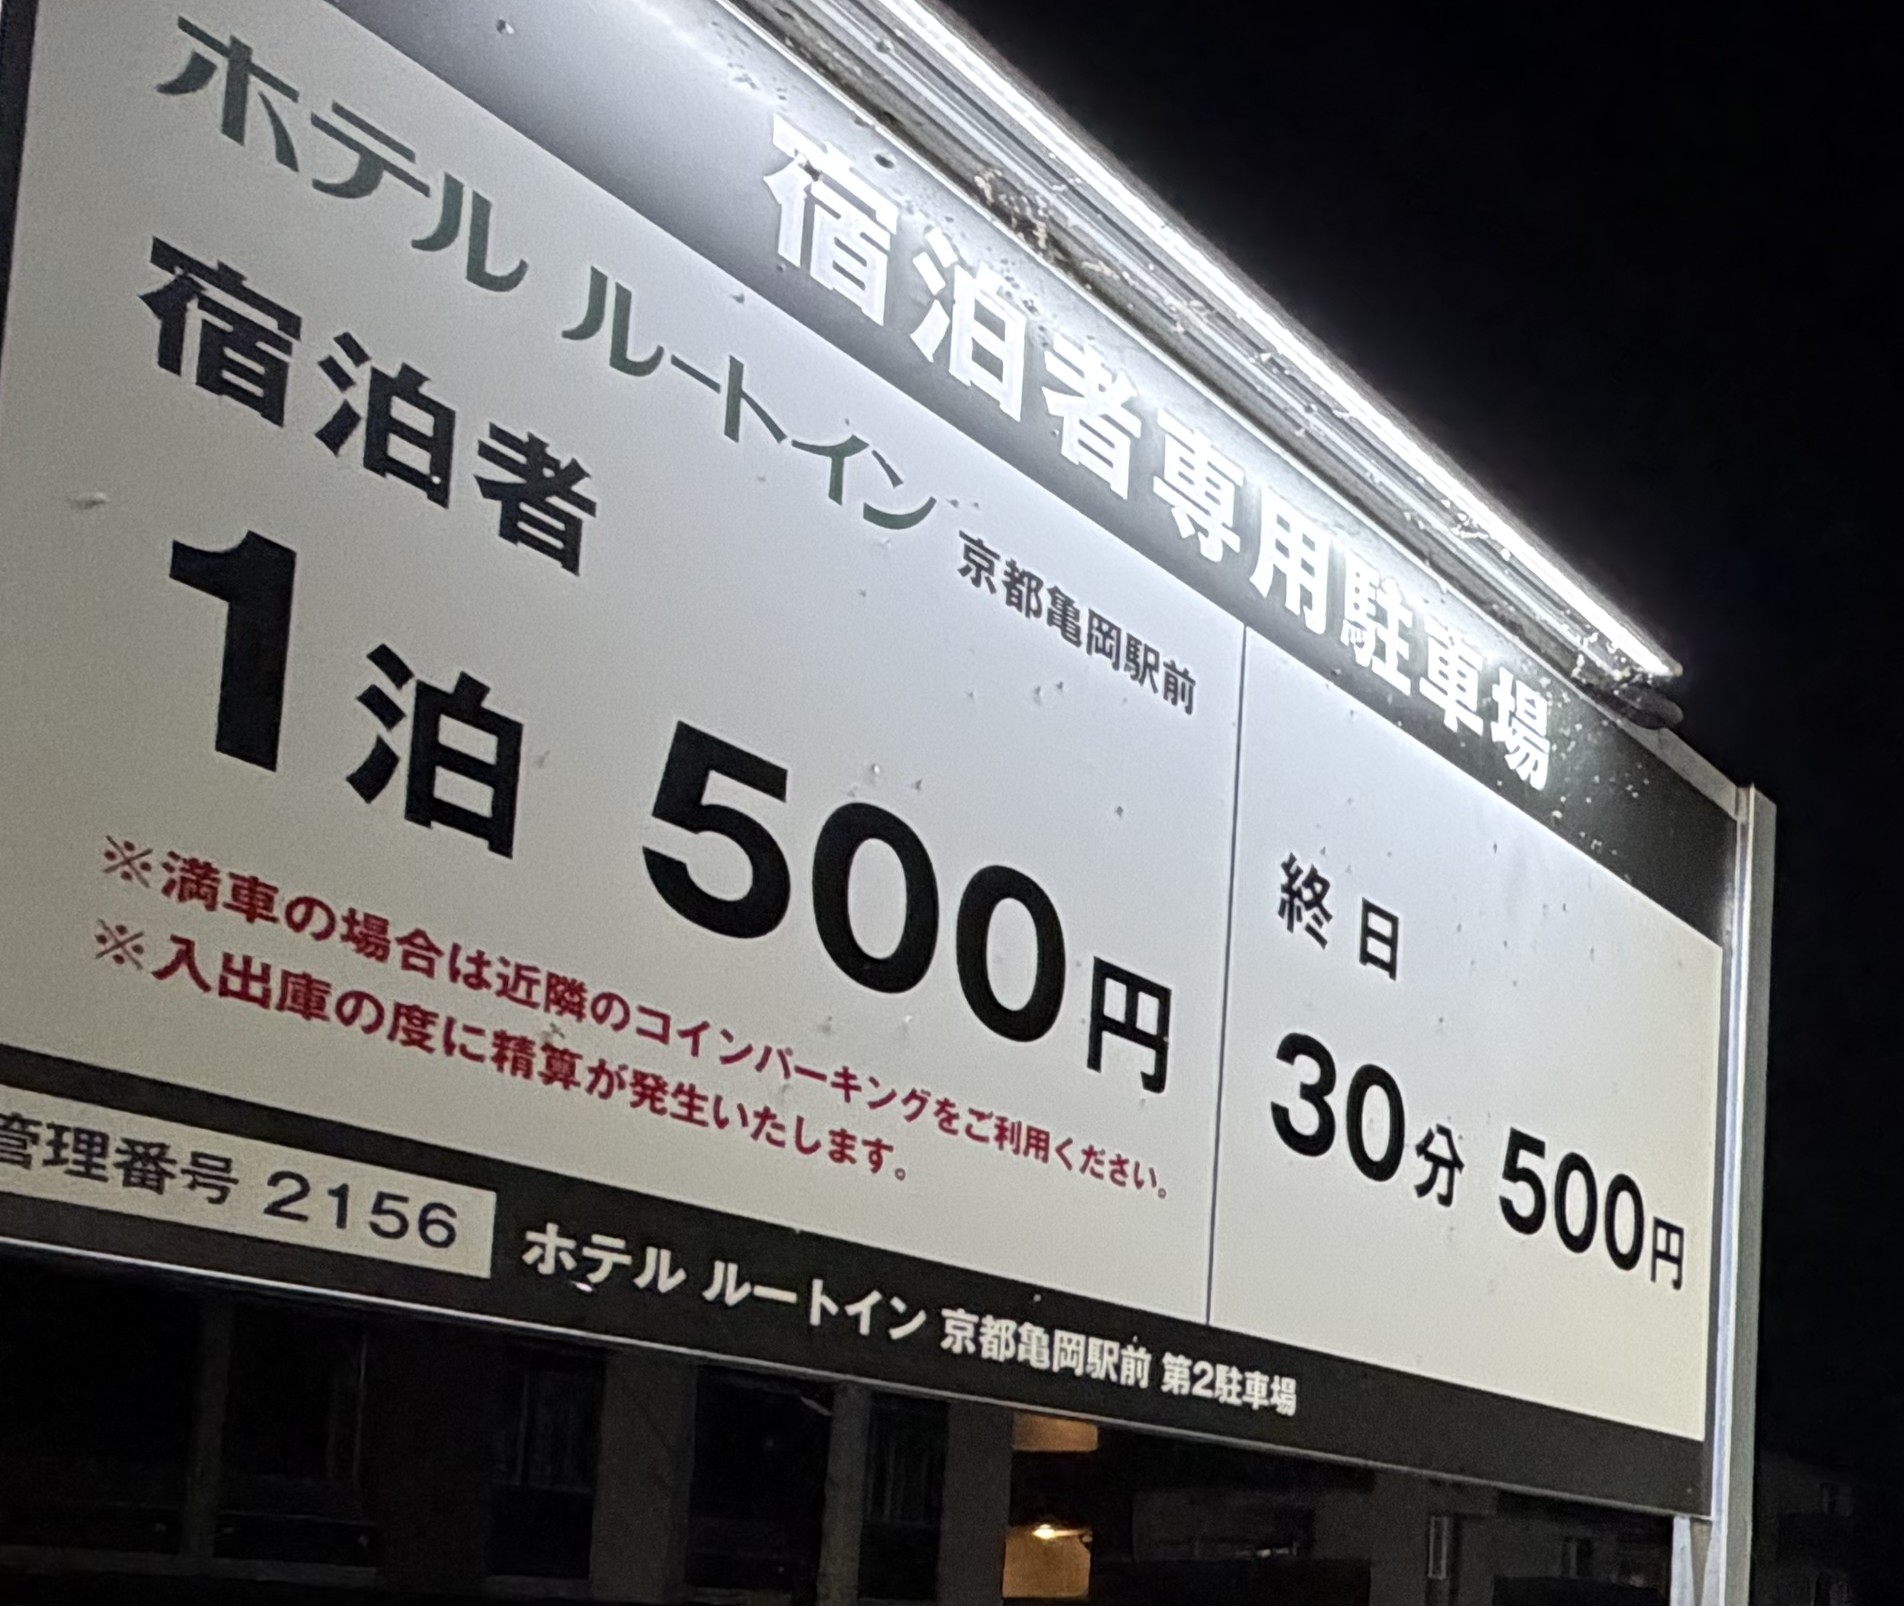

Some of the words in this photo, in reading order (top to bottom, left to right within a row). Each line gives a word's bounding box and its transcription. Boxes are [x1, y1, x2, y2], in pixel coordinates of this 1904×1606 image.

[138, 236, 597, 577] 宿泊者
[156, 15, 529, 293] ホテル
[562, 265, 936, 530] ルートイン
[957, 530, 1197, 716] 京都亀岡駅前
[763, 113, 1552, 792] 宿泊者専用駐車場
[169, 530, 524, 860] 1泊
[642, 720, 1173, 1095] 500円
[0, 1111, 240, 1206] 管理番号
[263, 1169, 459, 1249] 2156
[522, 1222, 687, 1295] ホテル
[703, 1259, 927, 1340] ルートイン
[941, 1307, 1152, 1390] 京都亀岡駅前
[1160, 1351, 1298, 1417] 第2駐車場
[1270, 1032, 1465, 1208] 30分
[1499, 1126, 1686, 1291] 500円
